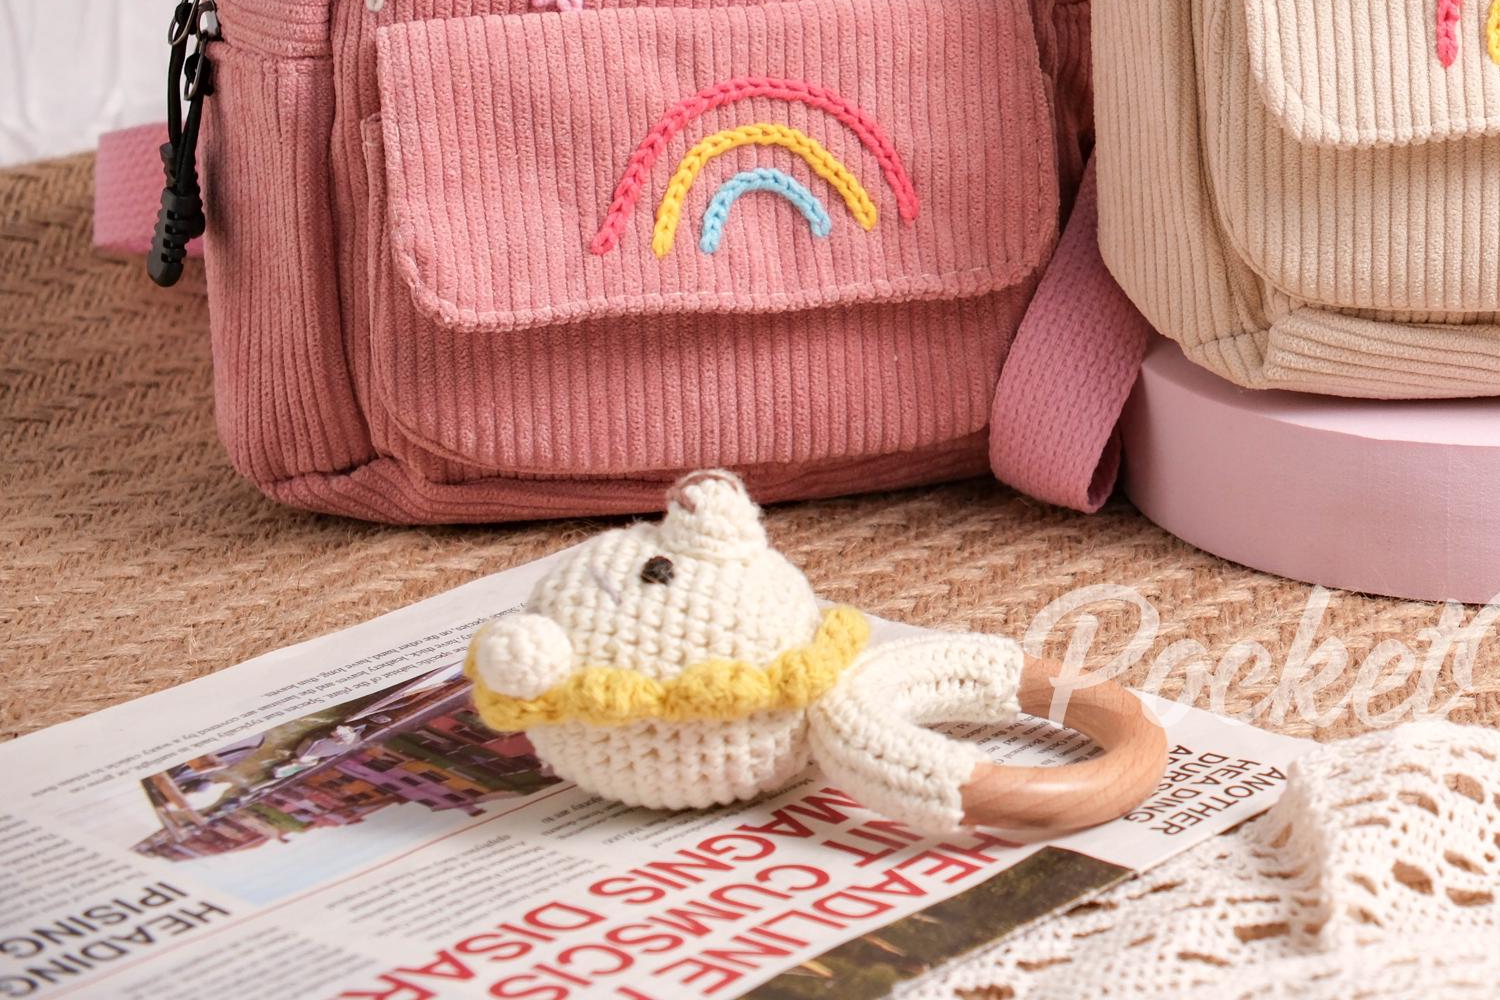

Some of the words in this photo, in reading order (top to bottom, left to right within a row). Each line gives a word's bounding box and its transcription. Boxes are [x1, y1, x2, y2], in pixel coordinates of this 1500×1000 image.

[588, 787, 866, 904] MAGNIS
[1149, 766, 1287, 835] ANOTHER
[0, 882, 188, 960] IPISING
[0, 901, 231, 998] HEADING
[652, 831, 1026, 995] HEADLINE
